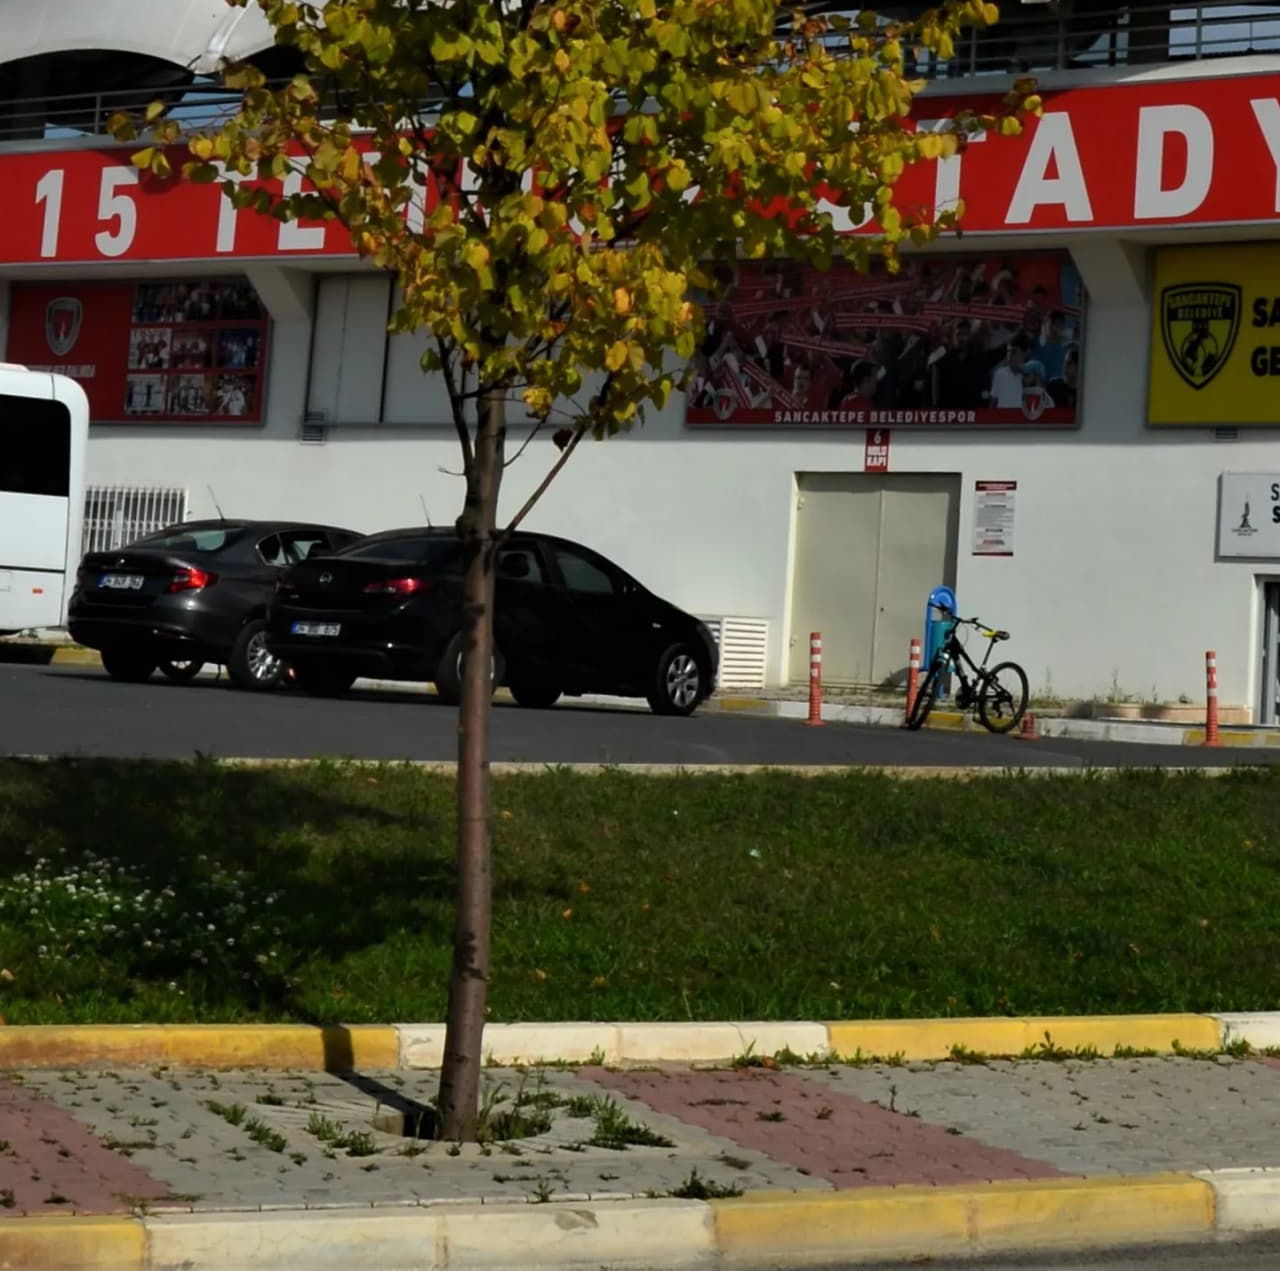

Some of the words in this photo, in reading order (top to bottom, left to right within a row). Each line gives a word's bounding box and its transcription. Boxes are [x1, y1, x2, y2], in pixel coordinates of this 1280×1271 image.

[35, 166, 140, 258] 15
[774, 410, 865, 423] SANCAKTEPE
[873, 430, 882, 444] 6
